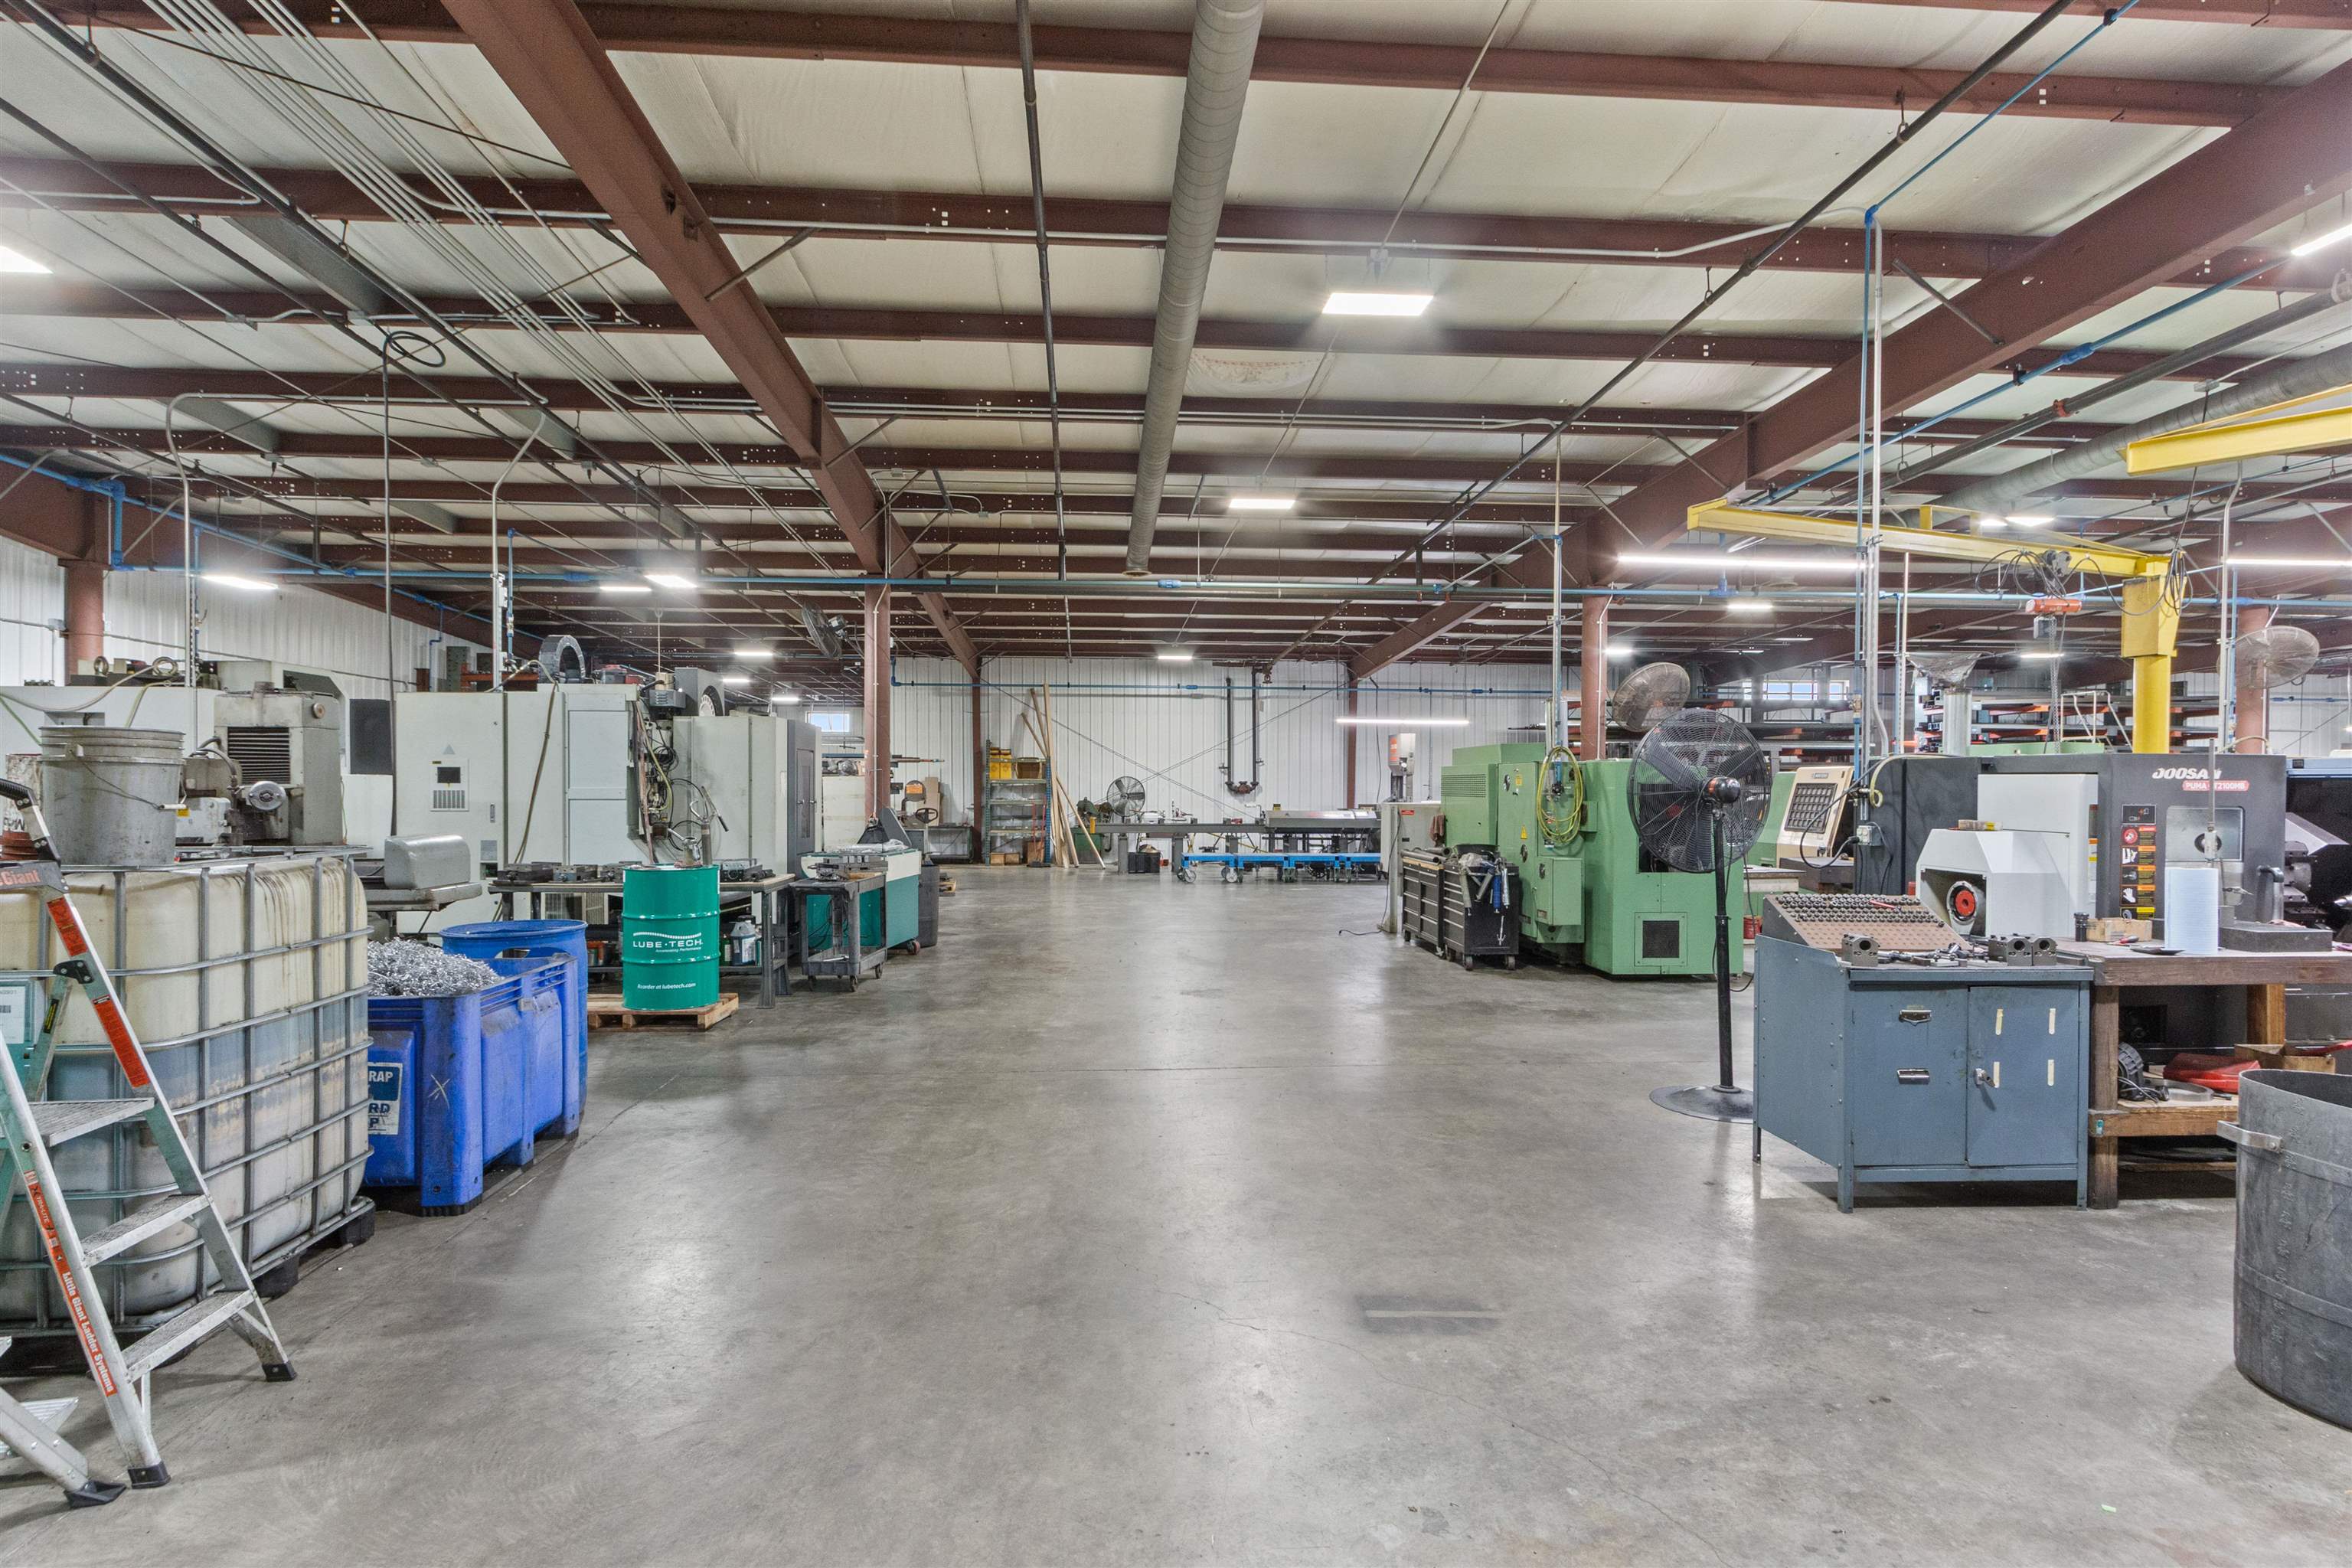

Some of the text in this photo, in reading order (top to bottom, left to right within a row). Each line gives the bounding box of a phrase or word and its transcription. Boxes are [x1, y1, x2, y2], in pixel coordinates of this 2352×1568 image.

[368, 1070, 394, 1082] RAP
[62, 1272, 114, 1393] Little Giant Ladder Systems
